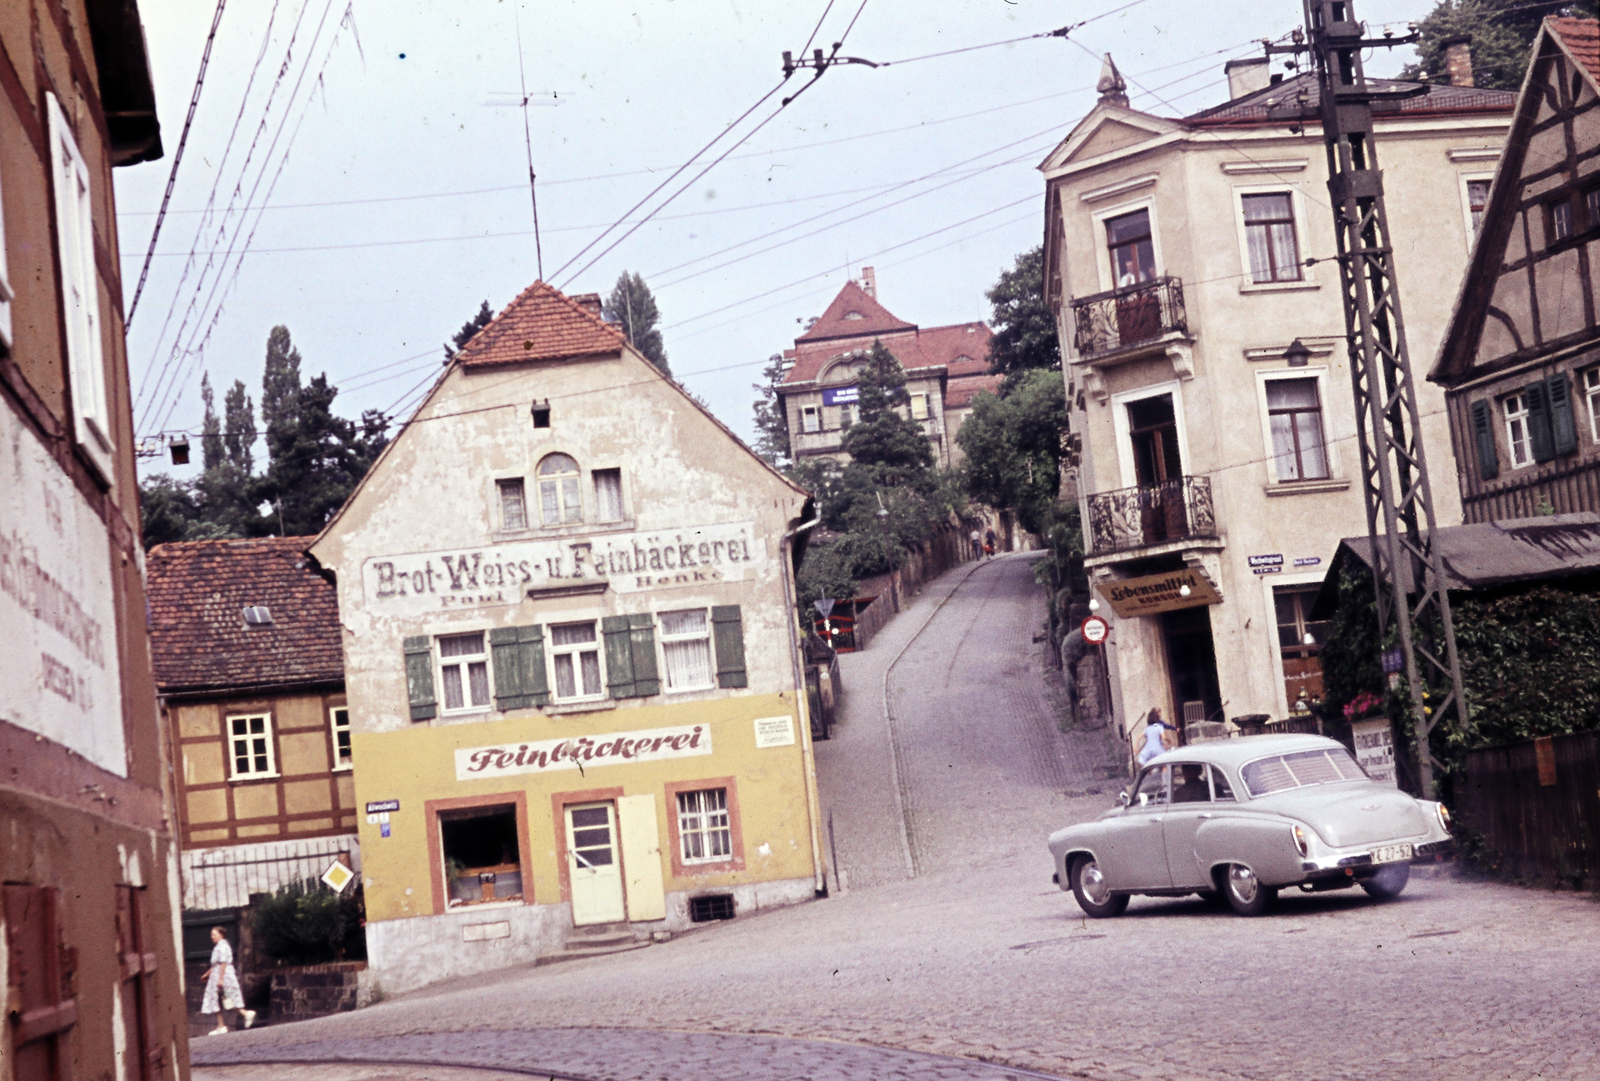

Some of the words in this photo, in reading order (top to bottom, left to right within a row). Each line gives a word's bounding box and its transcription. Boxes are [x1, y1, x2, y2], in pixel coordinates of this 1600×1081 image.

[440, 593, 505, 607] Paul
[634, 572, 726, 588] Henke
[467, 726, 703, 772] Feinbäckerei
